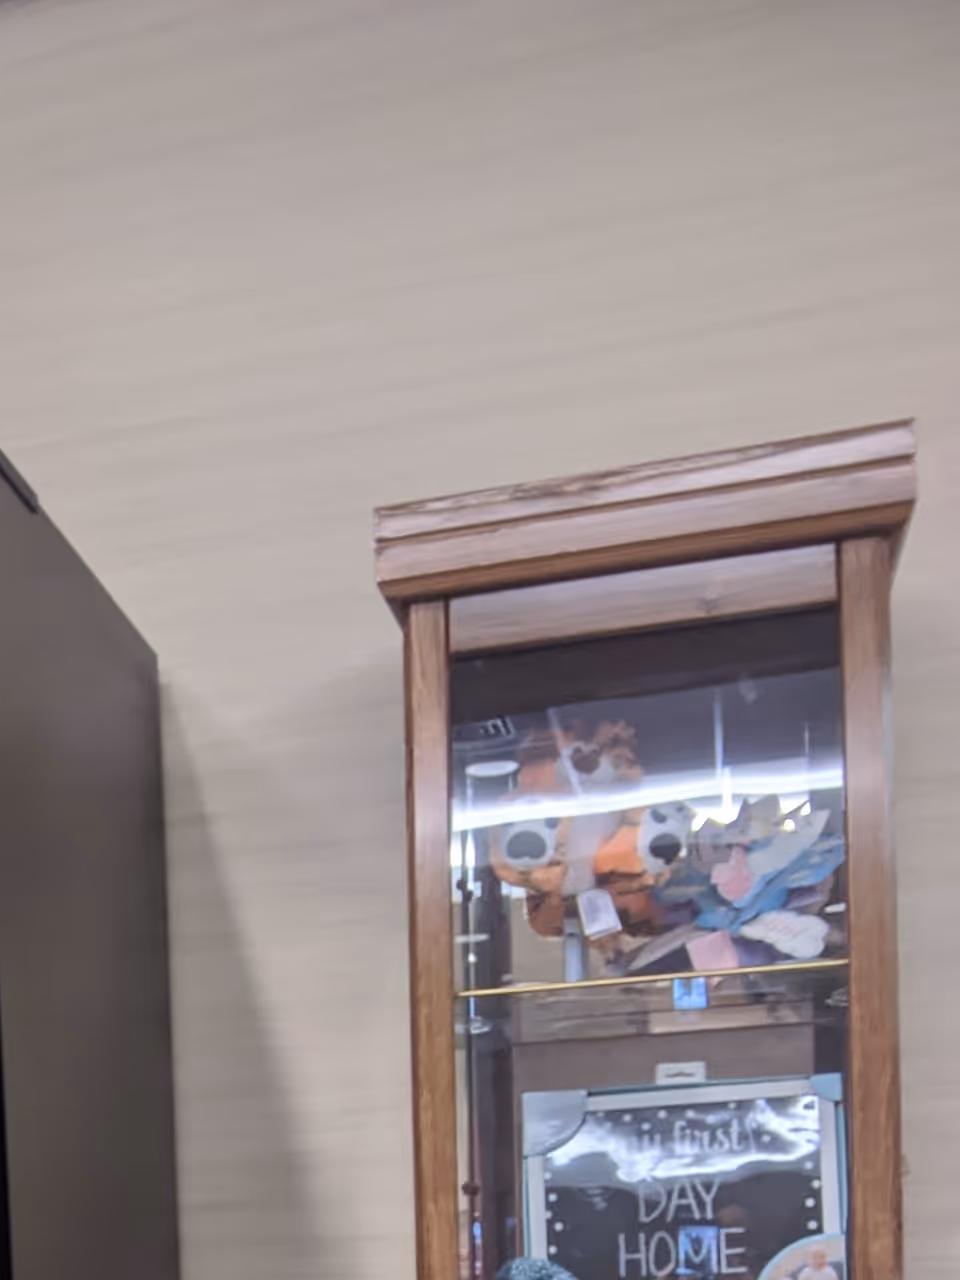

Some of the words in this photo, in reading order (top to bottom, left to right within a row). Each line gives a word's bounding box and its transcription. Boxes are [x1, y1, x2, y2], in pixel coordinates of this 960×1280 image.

[672, 1118, 745, 1155] first
[638, 1179, 720, 1223] DAY
[616, 1226, 750, 1278] HOME
